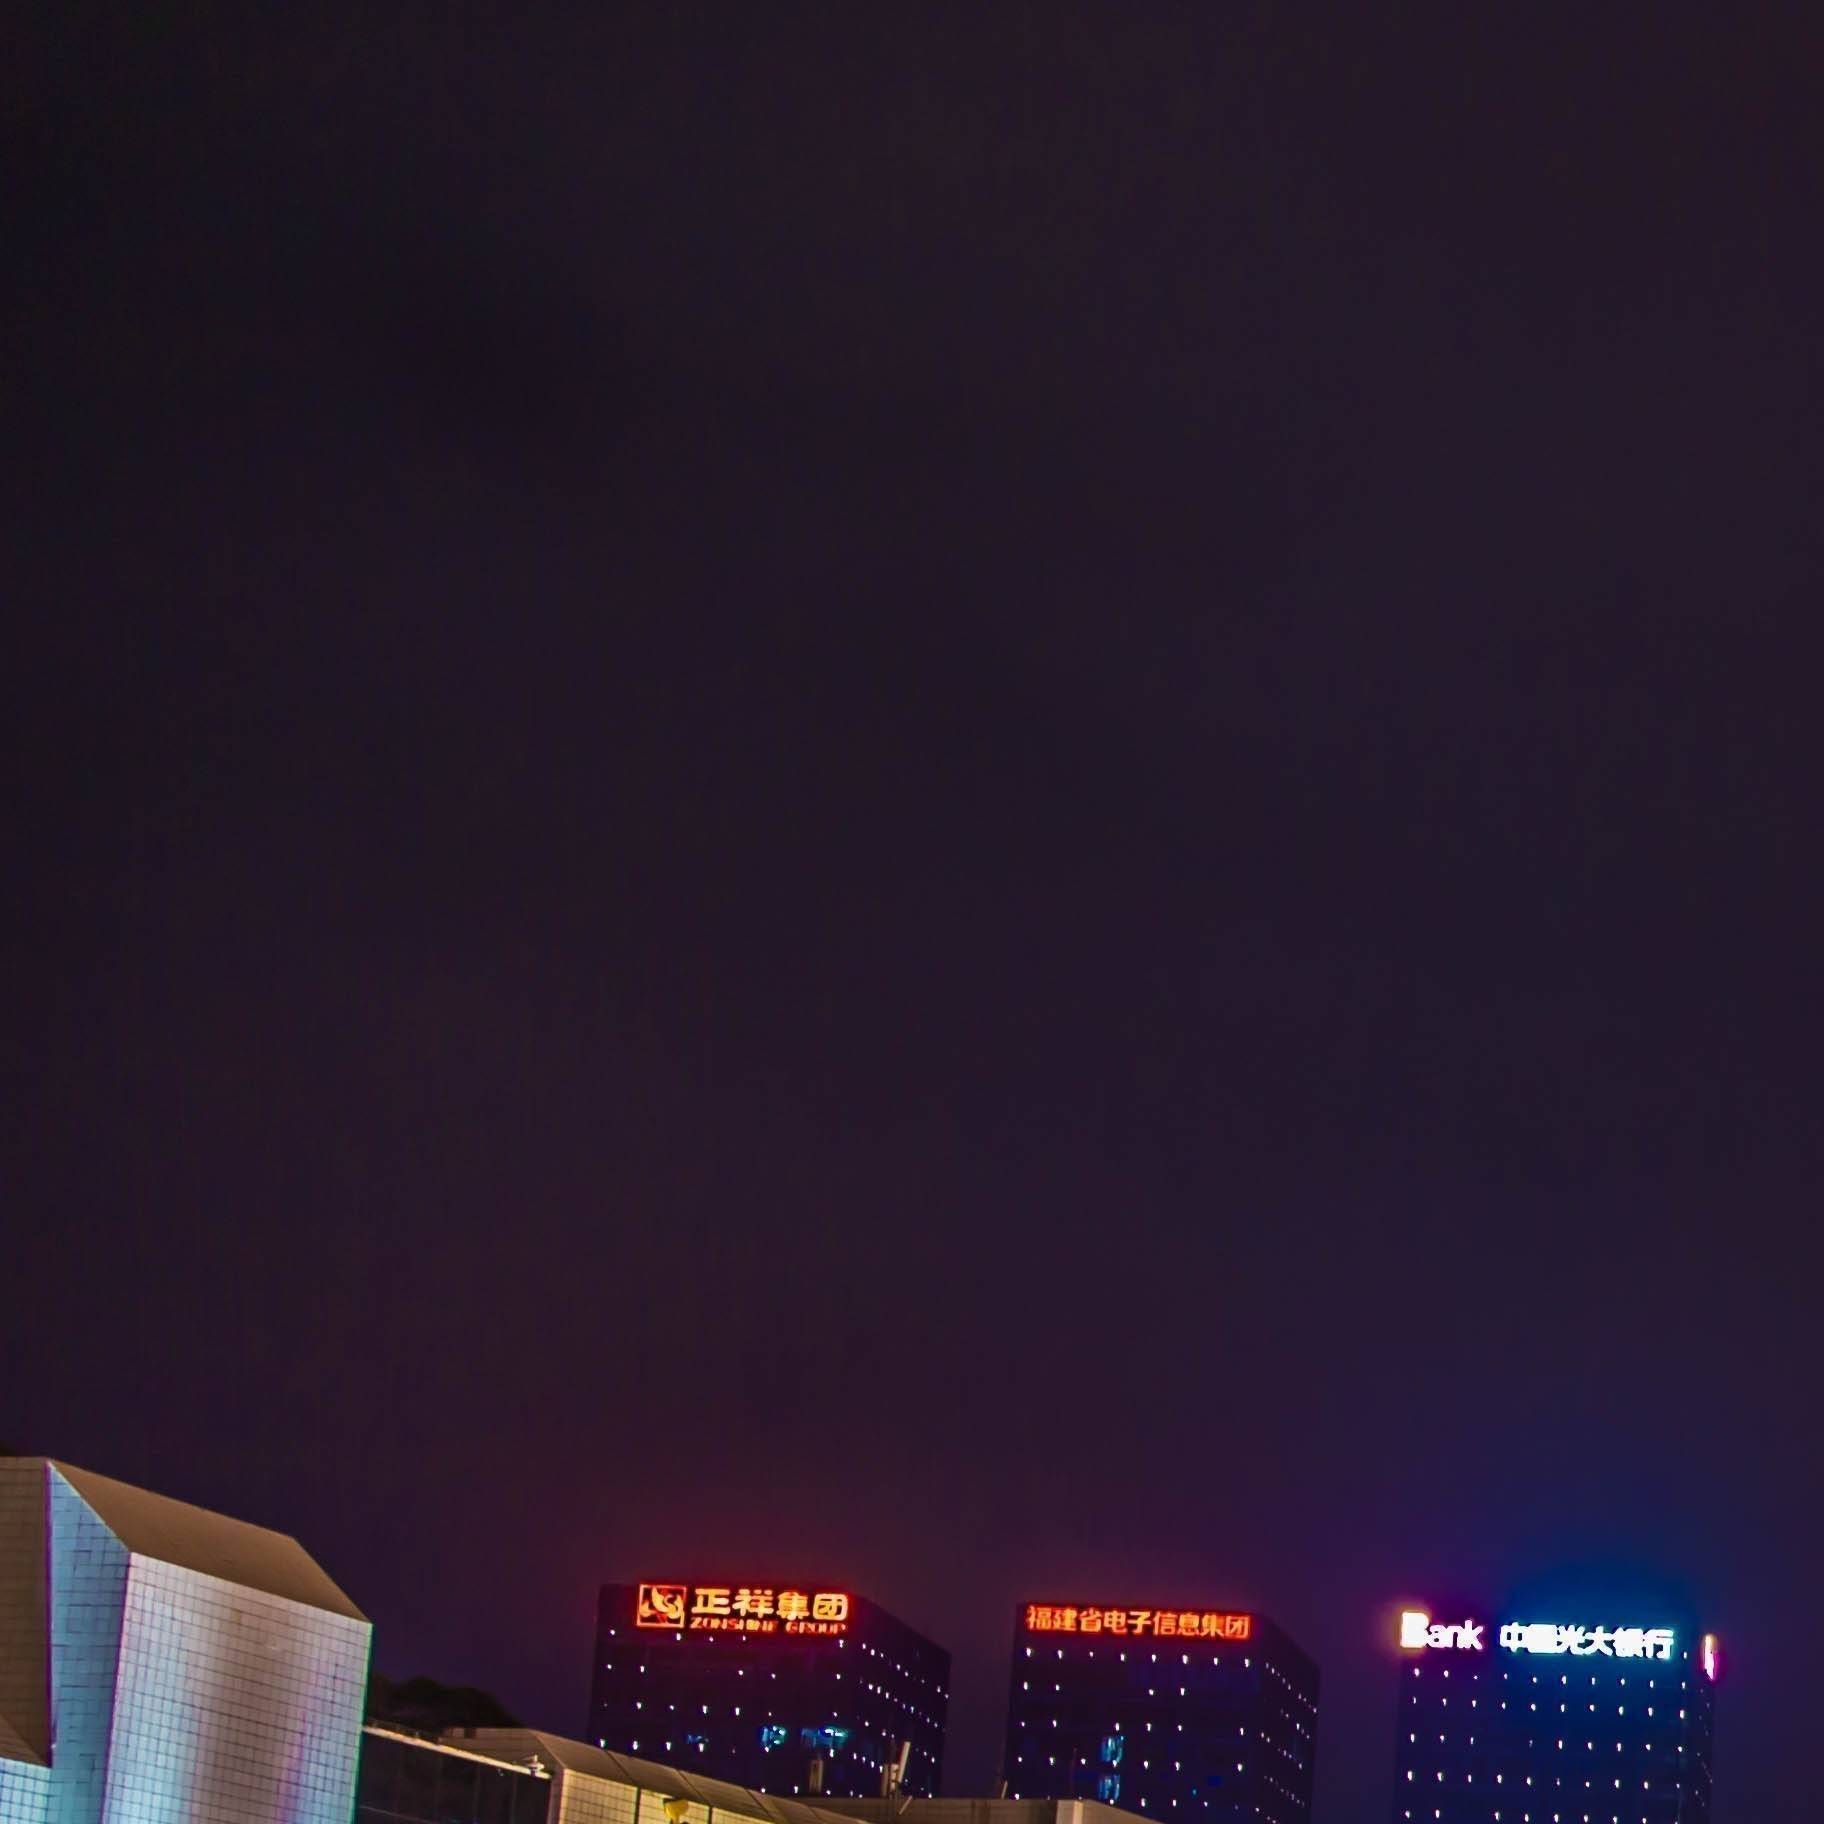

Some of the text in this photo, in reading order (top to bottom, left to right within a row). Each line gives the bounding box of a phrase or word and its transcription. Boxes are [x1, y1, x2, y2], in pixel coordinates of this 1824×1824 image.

[690, 1587, 849, 1621] 正祥集团
[1027, 1605, 1250, 1641] 福建省电子信息集团
[1500, 1621, 1674, 1659] 中国光大银行
